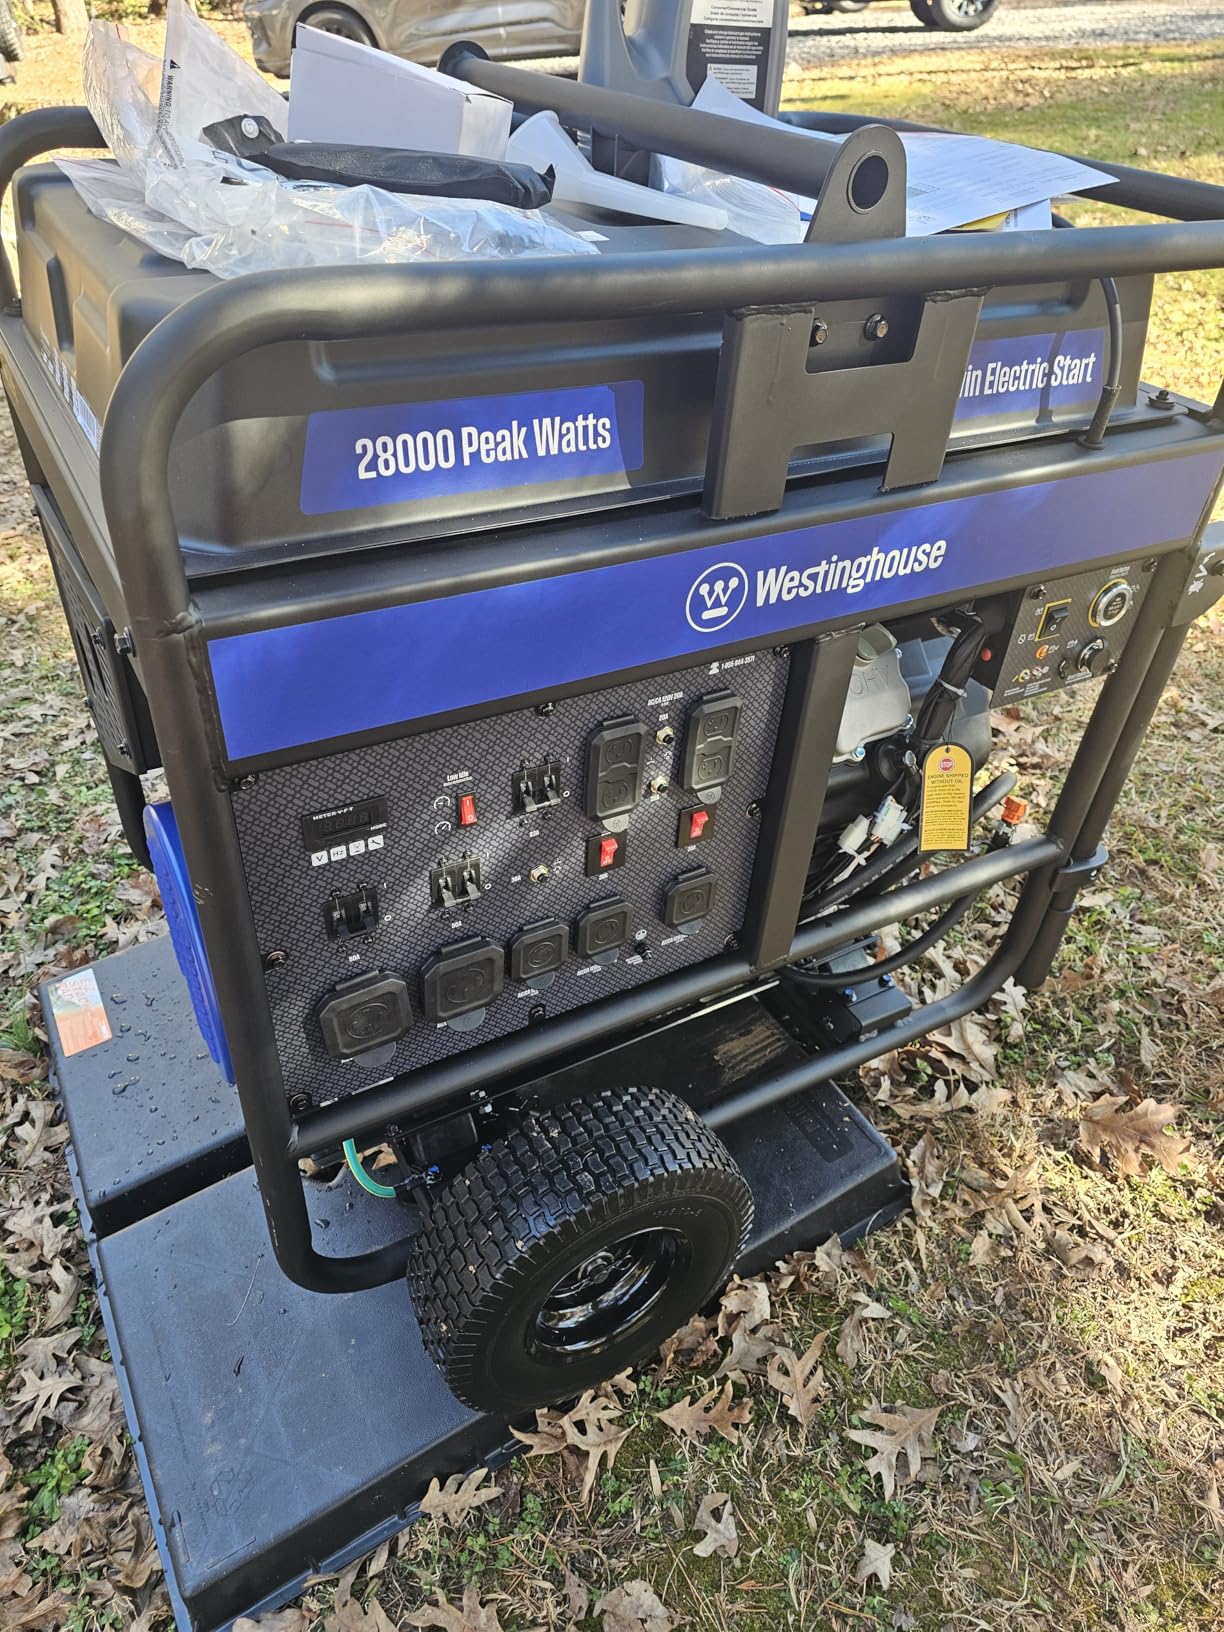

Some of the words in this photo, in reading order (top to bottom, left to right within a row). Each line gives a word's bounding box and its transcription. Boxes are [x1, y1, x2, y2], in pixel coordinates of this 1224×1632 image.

[959, 365, 983, 398] in
[984, 356, 1049, 395] Electric
[1051, 352, 1097, 387] Start
[355, 428, 456, 480] 28000
[461, 420, 529, 467] Peak
[533, 412, 611, 457] Watts
[756, 540, 947, 608] Westinghouse
[446, 773, 459, 782] Low
[316, 854, 324, 862] V
[332, 849, 344, 858] Hz
